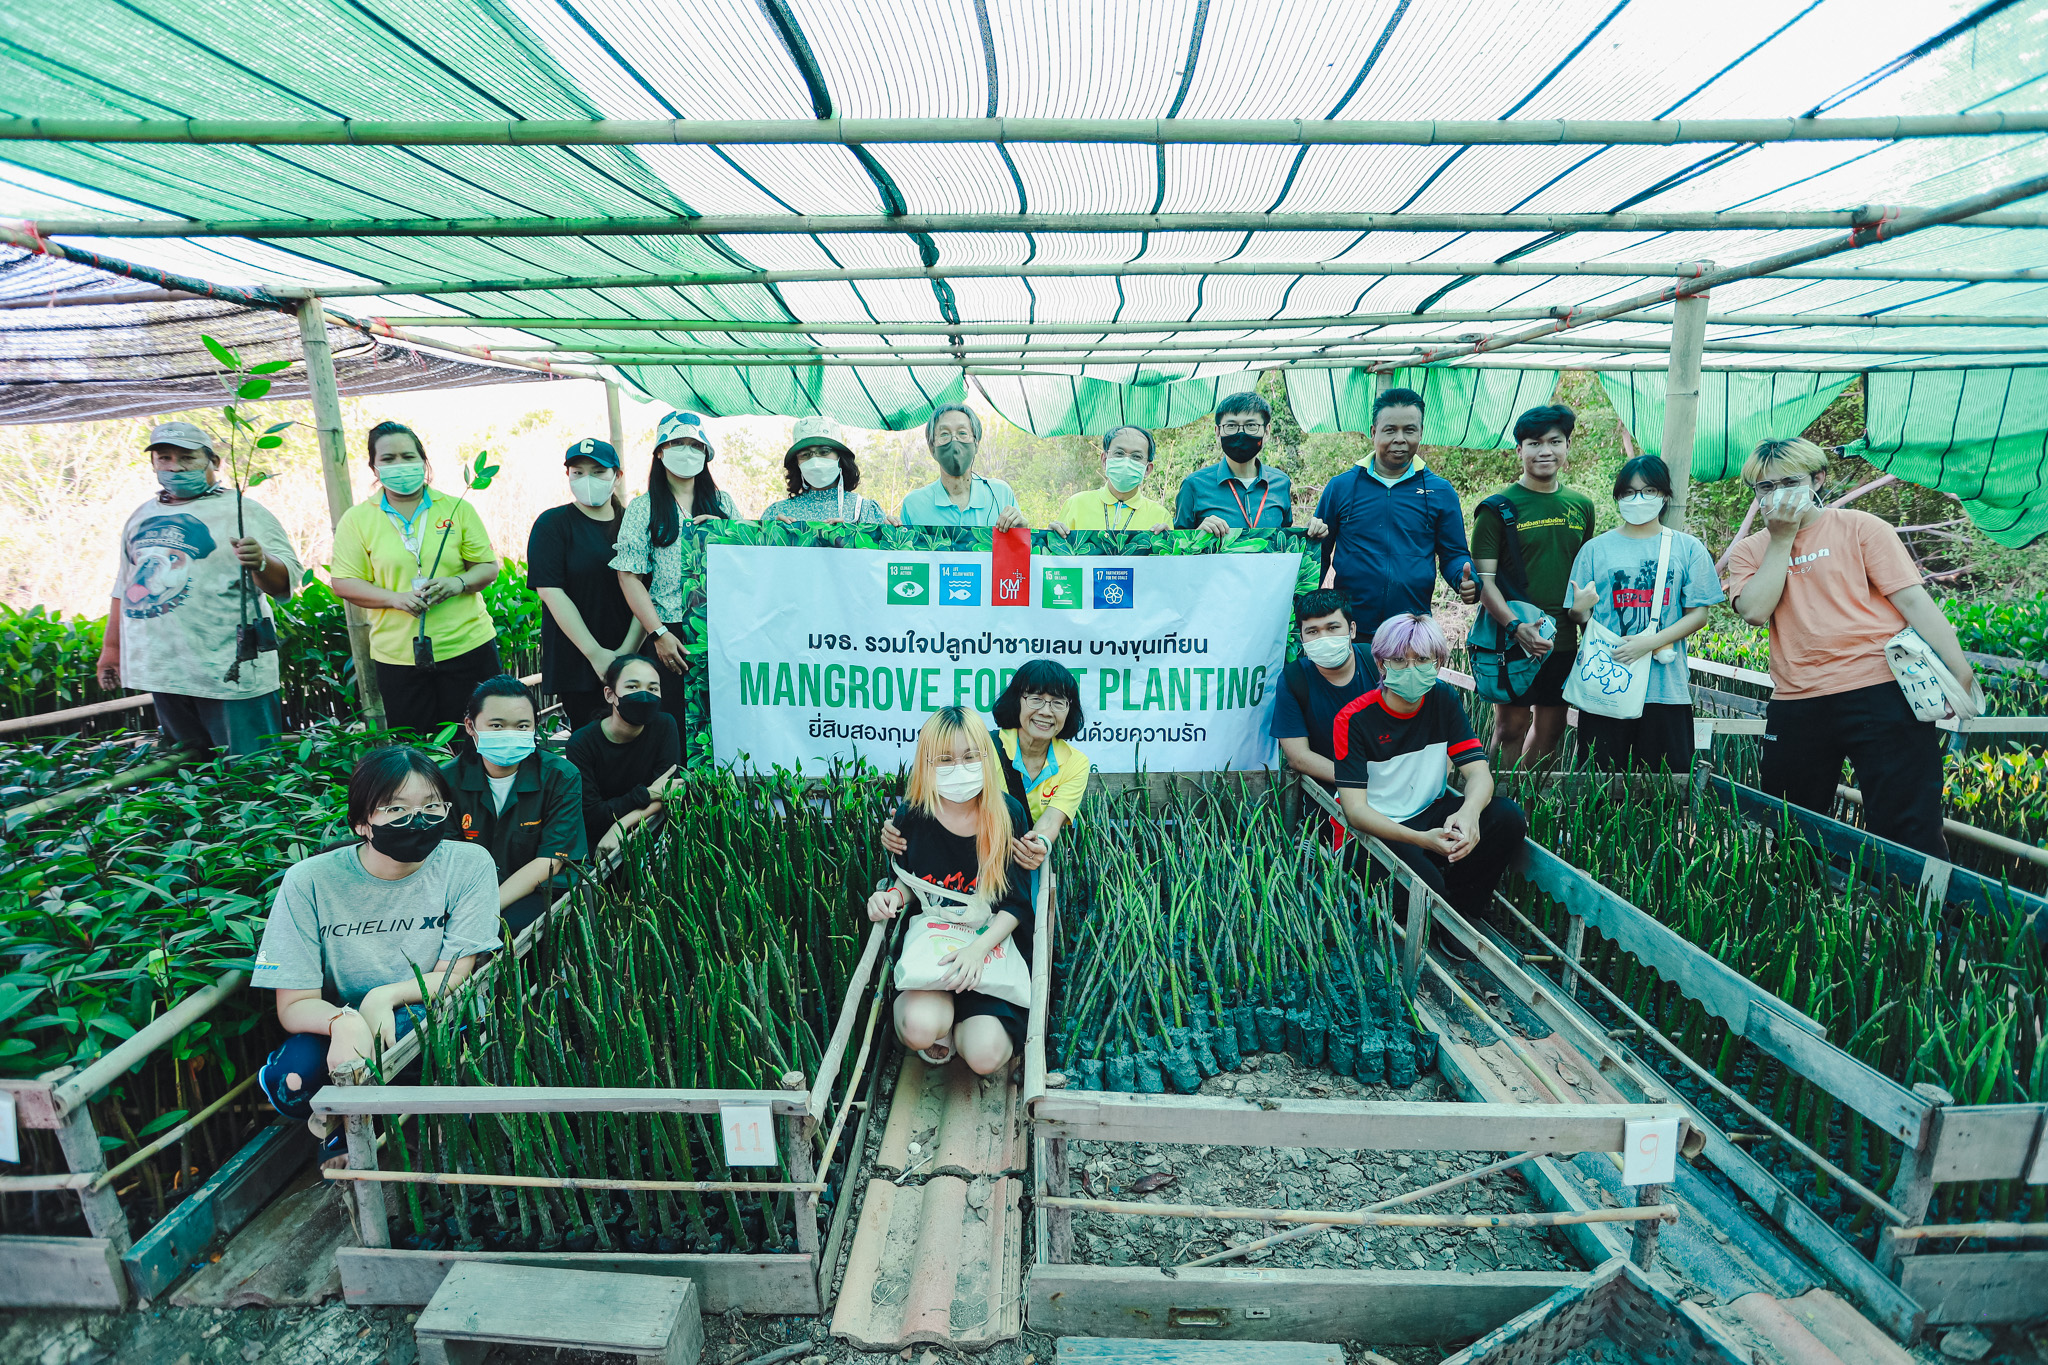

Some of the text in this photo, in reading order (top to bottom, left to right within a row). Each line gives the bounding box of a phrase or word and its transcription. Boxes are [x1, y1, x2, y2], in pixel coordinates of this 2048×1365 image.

[580, 438, 595, 454] C
[890, 565, 899, 576] 13
[942, 567, 950, 577] 14
[1045, 571, 1053, 580] 15
[1096, 571, 1104, 580] 17
[808, 630, 1208, 662] มจธ. รวมใจปลูกป่าชายเลน บางขุนเทียน
[740, 662, 1267, 713] MANGROVE FOT PLANTING
[809, 713, 920, 748] ยี่สิบสองกุม
[1070, 722, 1207, 742] นด้วยความรัก
[1697, 728, 1705, 742] 6
[730, 1122, 764, 1152] 11
[1640, 1133, 1660, 1174] 9
